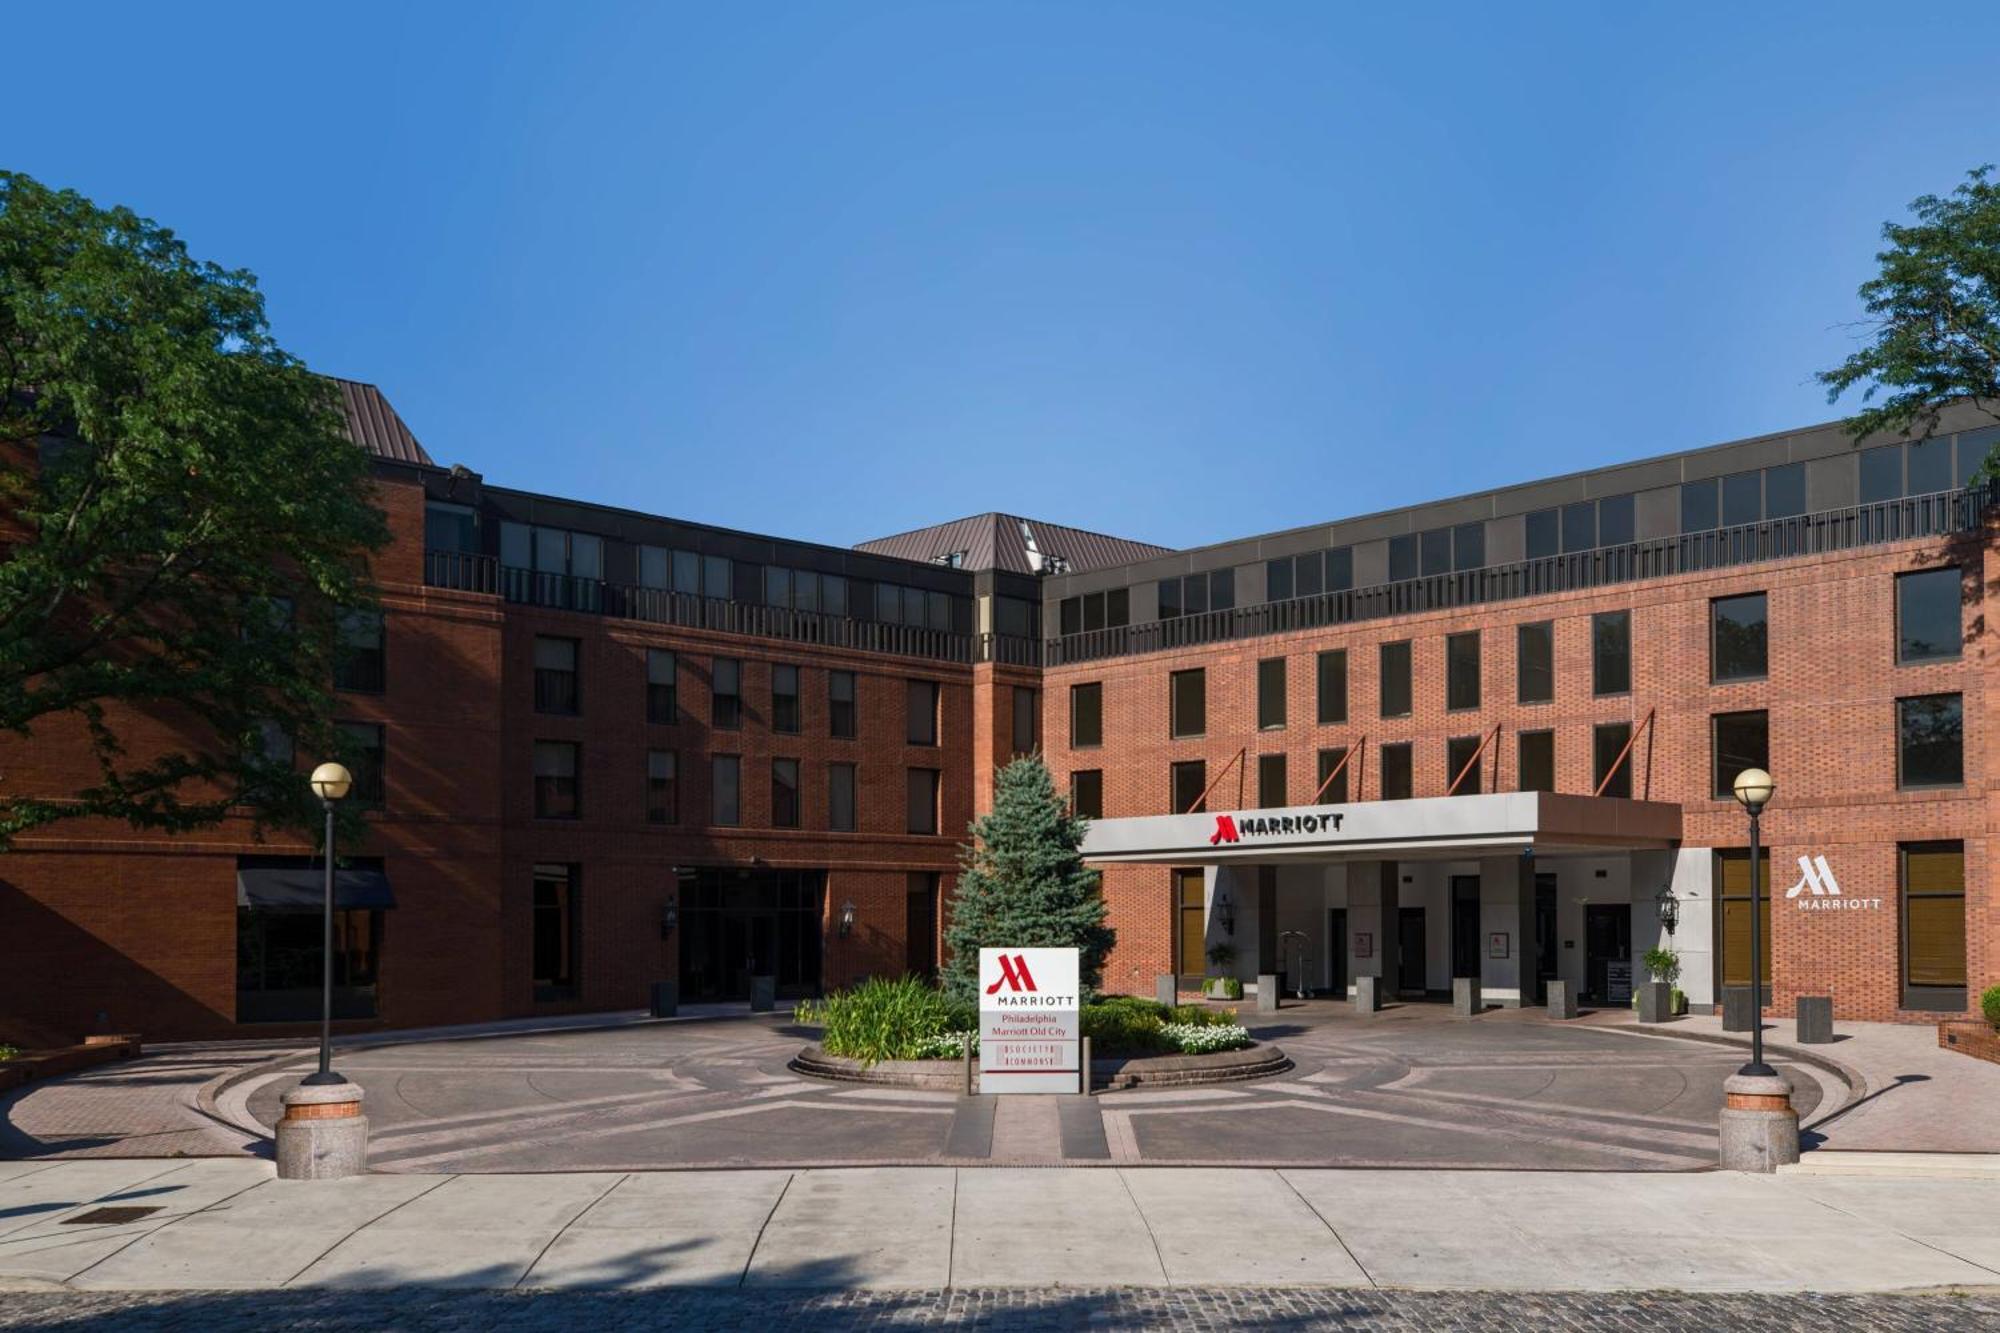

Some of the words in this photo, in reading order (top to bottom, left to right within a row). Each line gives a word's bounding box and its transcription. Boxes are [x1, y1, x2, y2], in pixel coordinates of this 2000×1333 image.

[1240, 813, 1344, 836] MARRIOTT
[1798, 899, 1881, 910] MARRIOTT
[998, 996, 1073, 1006] MARRIOTT
[1002, 1014, 1057, 1024] Philadelphia
[992, 1027, 1028, 1036] Marriott
[1030, 1027, 1046, 1036] Old
[1048, 1027, 1066, 1037] City
